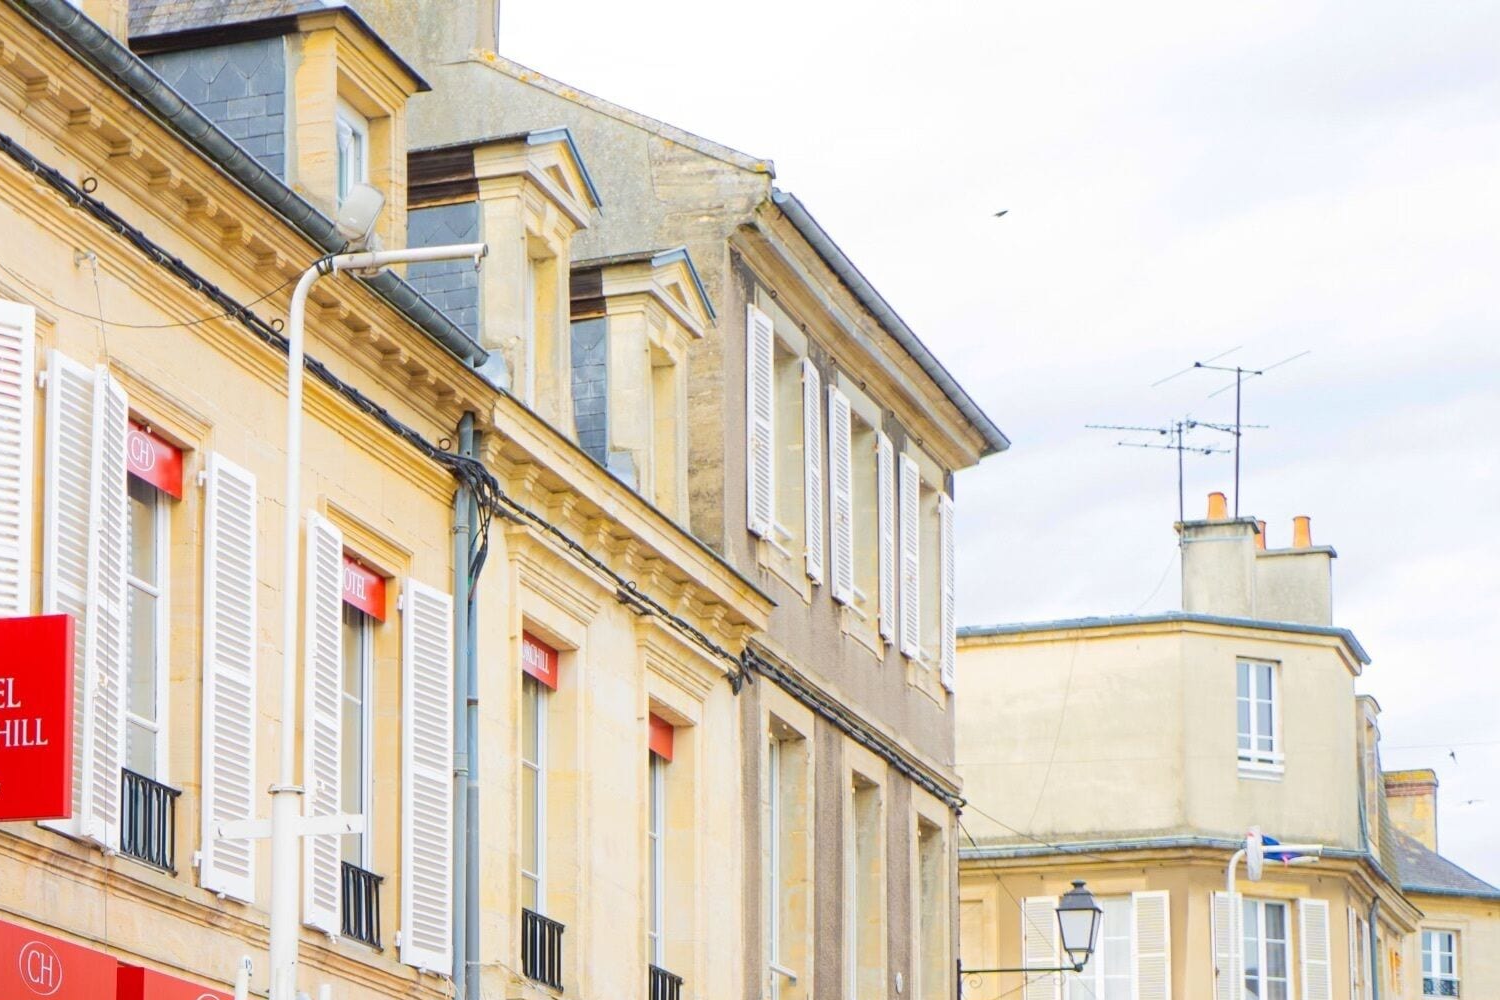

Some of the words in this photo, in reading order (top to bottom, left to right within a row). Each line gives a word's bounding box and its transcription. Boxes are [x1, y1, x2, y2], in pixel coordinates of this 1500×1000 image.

[131, 436, 150, 467] CH
[344, 567, 367, 600] OTEL
[27, 949, 54, 988] CH
